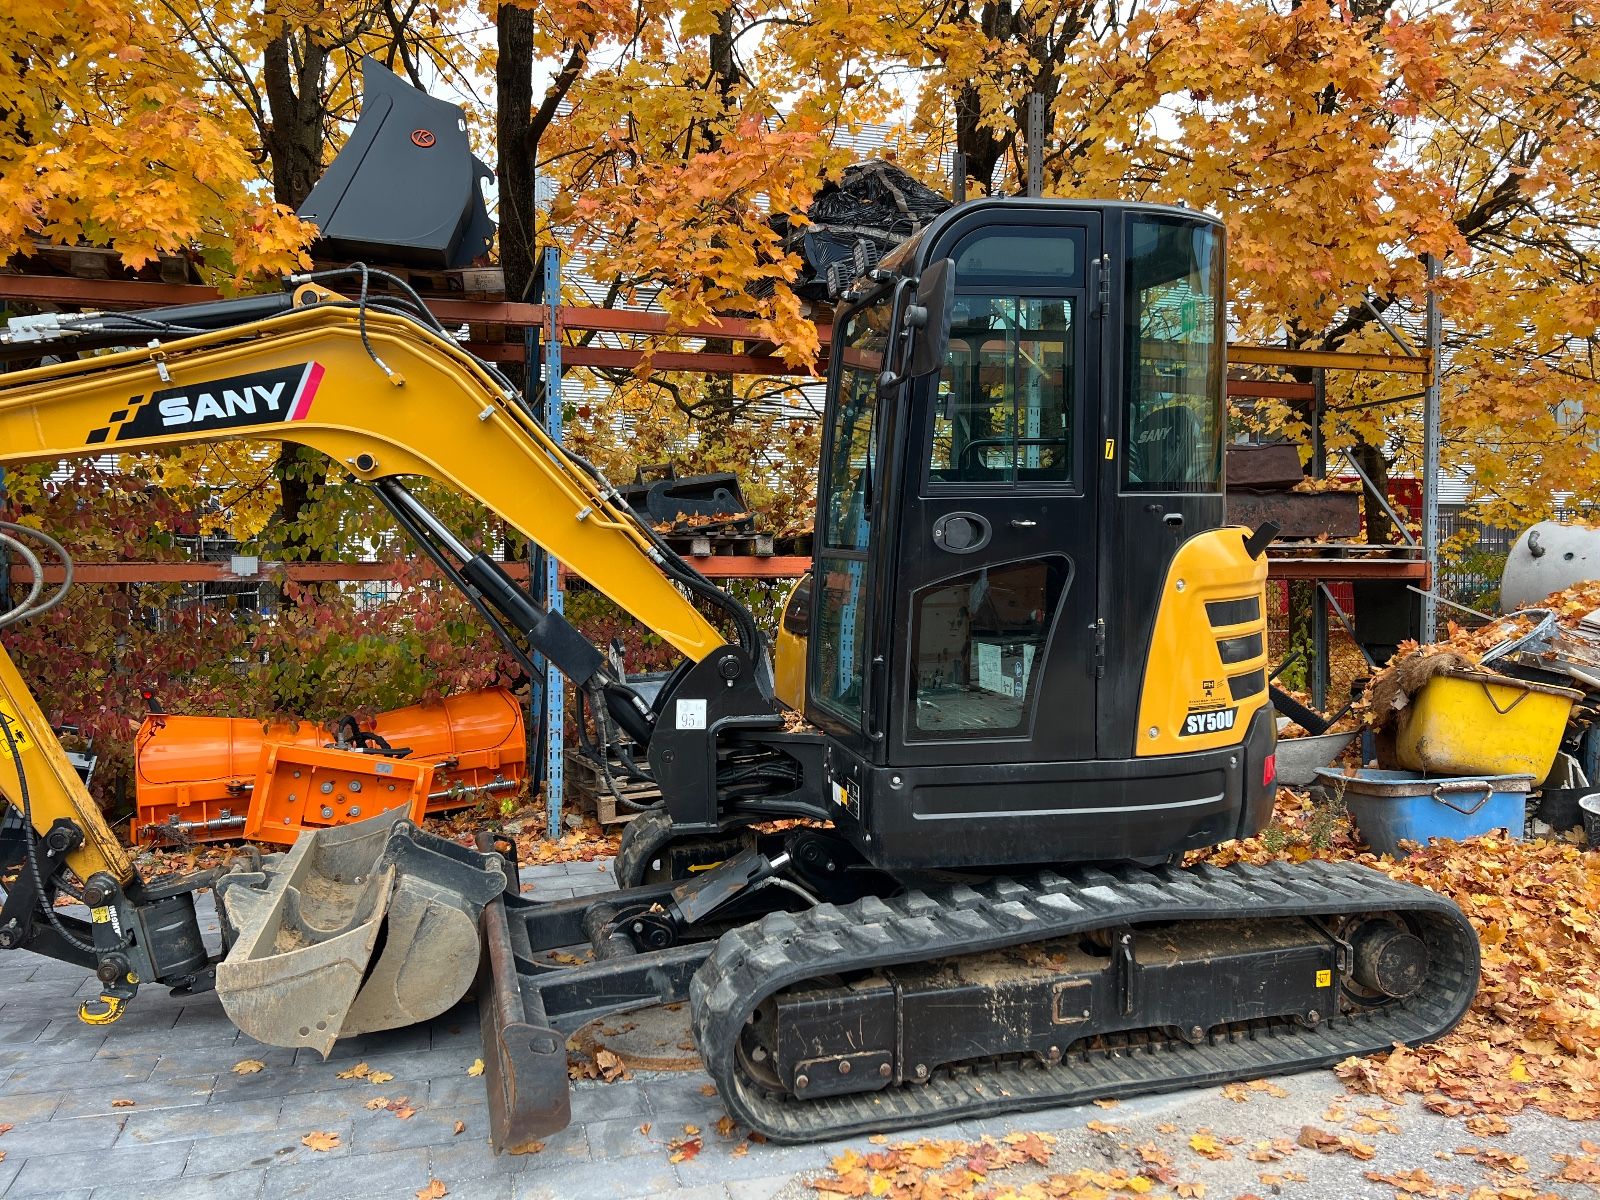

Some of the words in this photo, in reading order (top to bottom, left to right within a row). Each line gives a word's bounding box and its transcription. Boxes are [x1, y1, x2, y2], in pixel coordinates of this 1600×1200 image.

[158, 381, 286, 427] SANY
[1137, 426, 1172, 443] SANY
[681, 713, 695, 728] 95
[1187, 710, 1234, 733] SY50U
